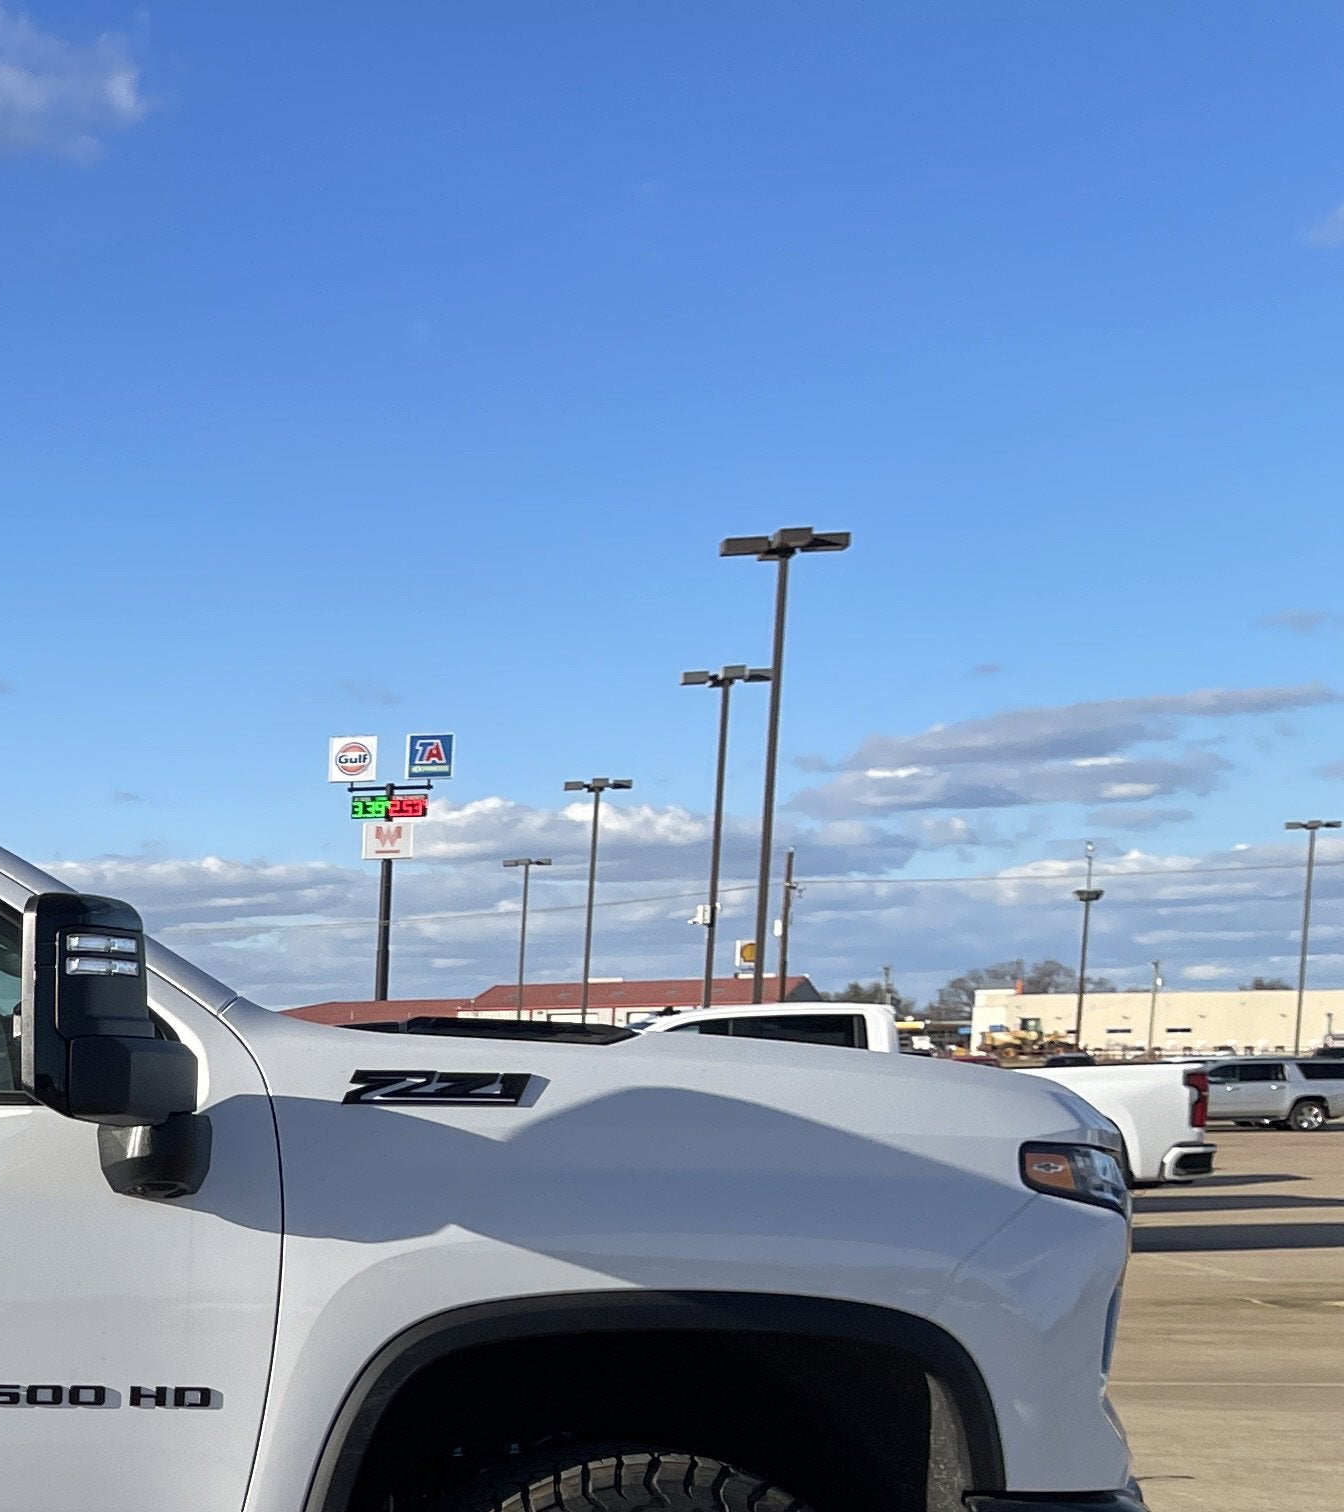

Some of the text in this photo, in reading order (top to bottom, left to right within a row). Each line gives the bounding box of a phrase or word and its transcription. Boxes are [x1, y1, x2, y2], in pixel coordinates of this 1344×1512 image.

[338, 753, 368, 764] Gulf
[415, 740, 447, 765] TA
[341, 1069, 532, 1106] Z71
[129, 1386, 211, 1407] HD
